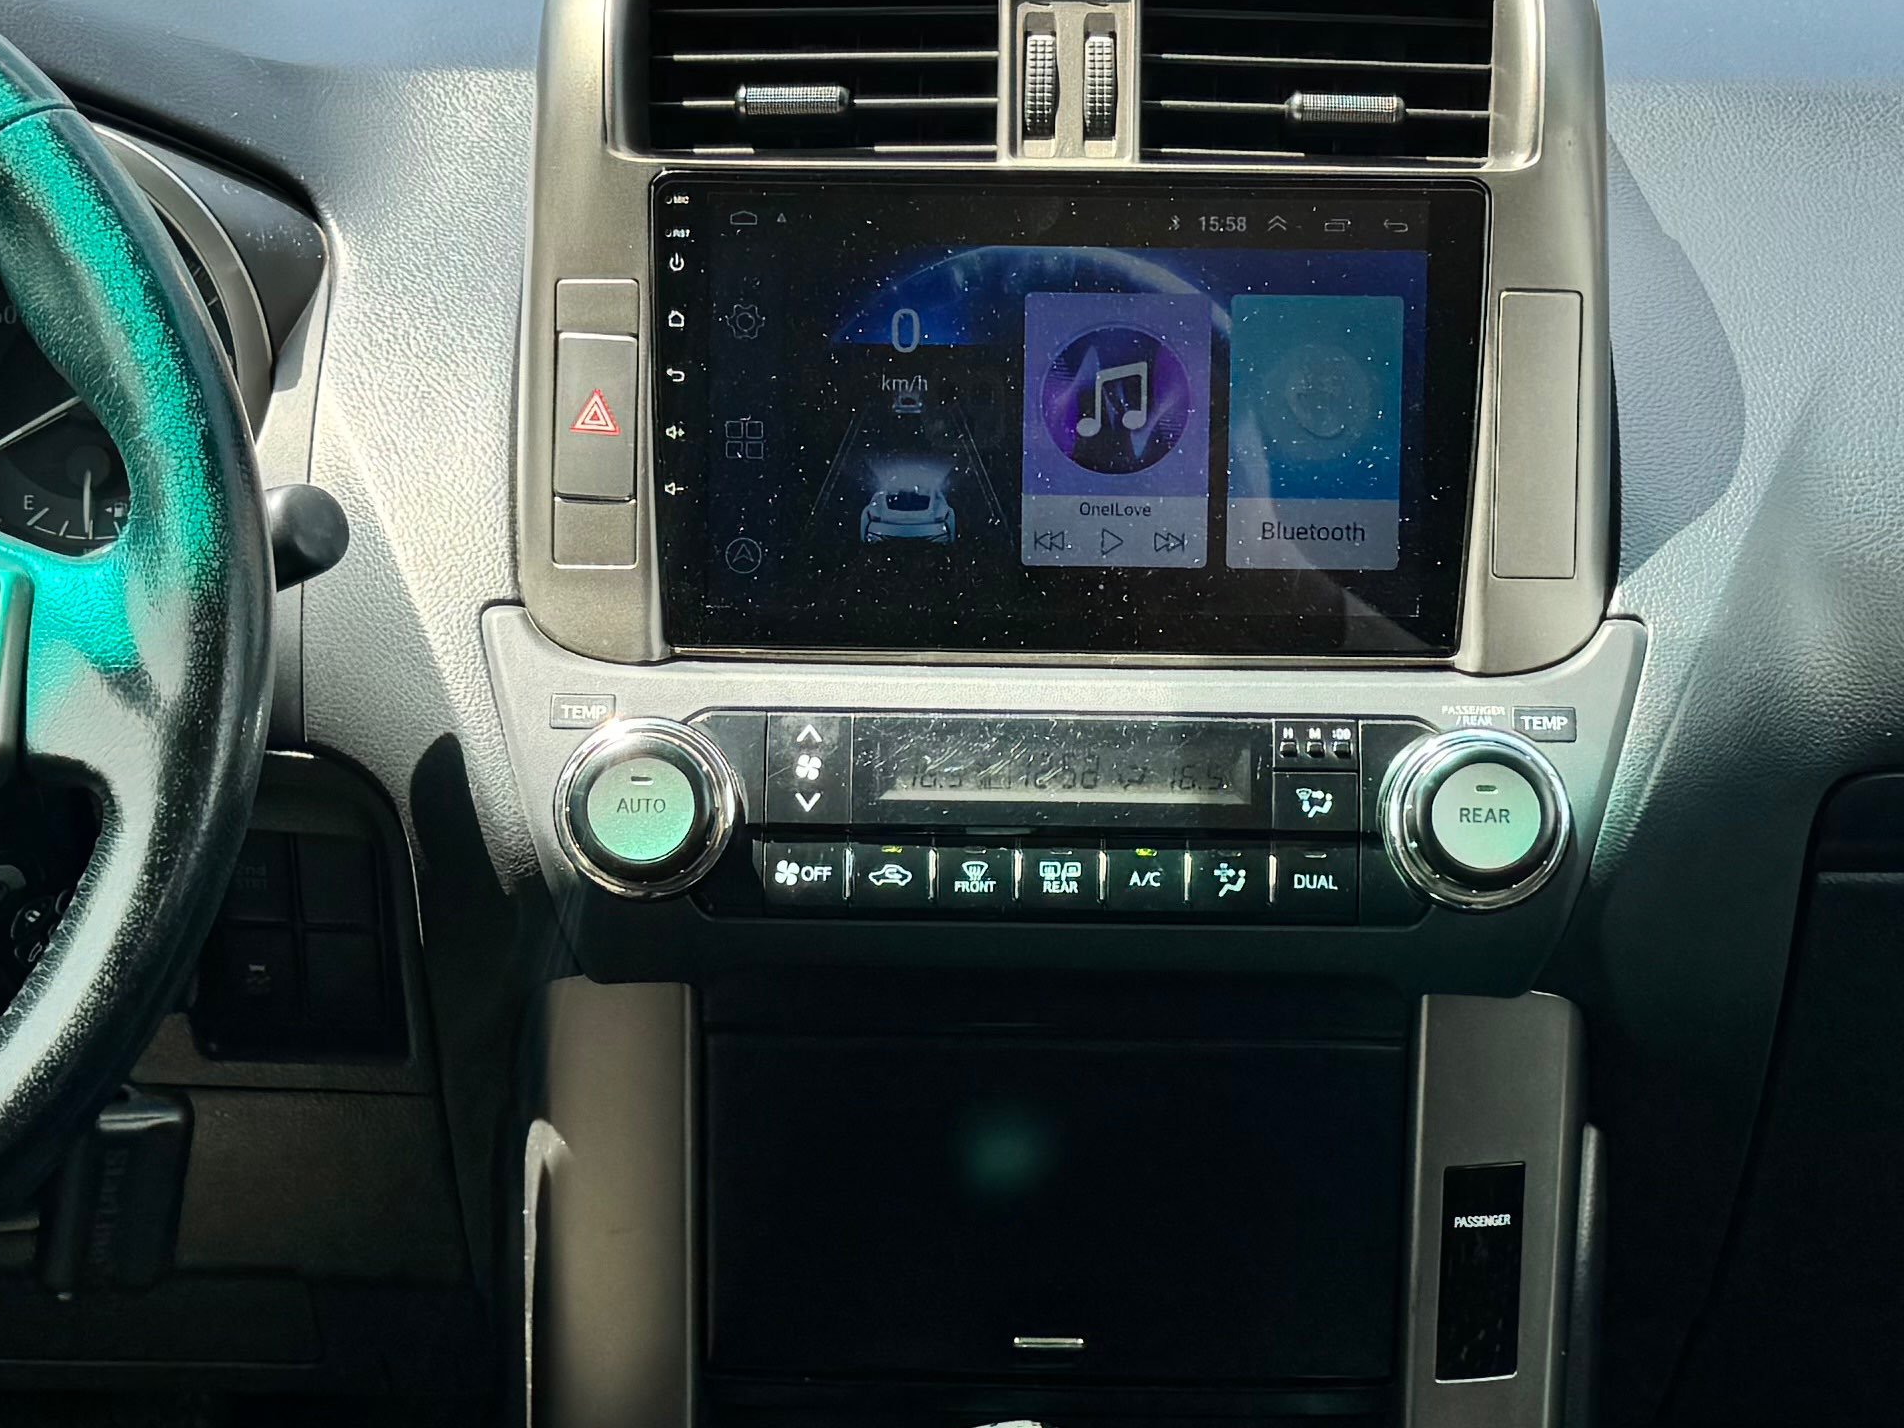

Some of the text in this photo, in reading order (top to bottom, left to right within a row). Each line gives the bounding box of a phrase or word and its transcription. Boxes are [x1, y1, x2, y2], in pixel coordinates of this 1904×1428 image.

[1198, 216, 1246, 232] 15:58
[892, 308, 920, 352] 0
[881, 374, 928, 392] km/h
[24, 495, 34, 510] E
[1261, 522, 1366, 542] Bluetooth
[561, 704, 608, 720] TEMP
[1442, 705, 1506, 716] PASSENGER
[1520, 715, 1569, 731] TEMP
[1283, 727, 1294, 739] H
[1308, 728, 1321, 740] M
[616, 798, 666, 813] AUTO
[1459, 807, 1510, 823] REAR
[801, 865, 832, 882] OFF
[1129, 871, 1161, 887] A/C
[954, 880, 996, 893] FRONT
[1043, 880, 1078, 894] REAR
[1293, 873, 1338, 891] DUAL
[1454, 1213, 1511, 1228] PASSENGER
